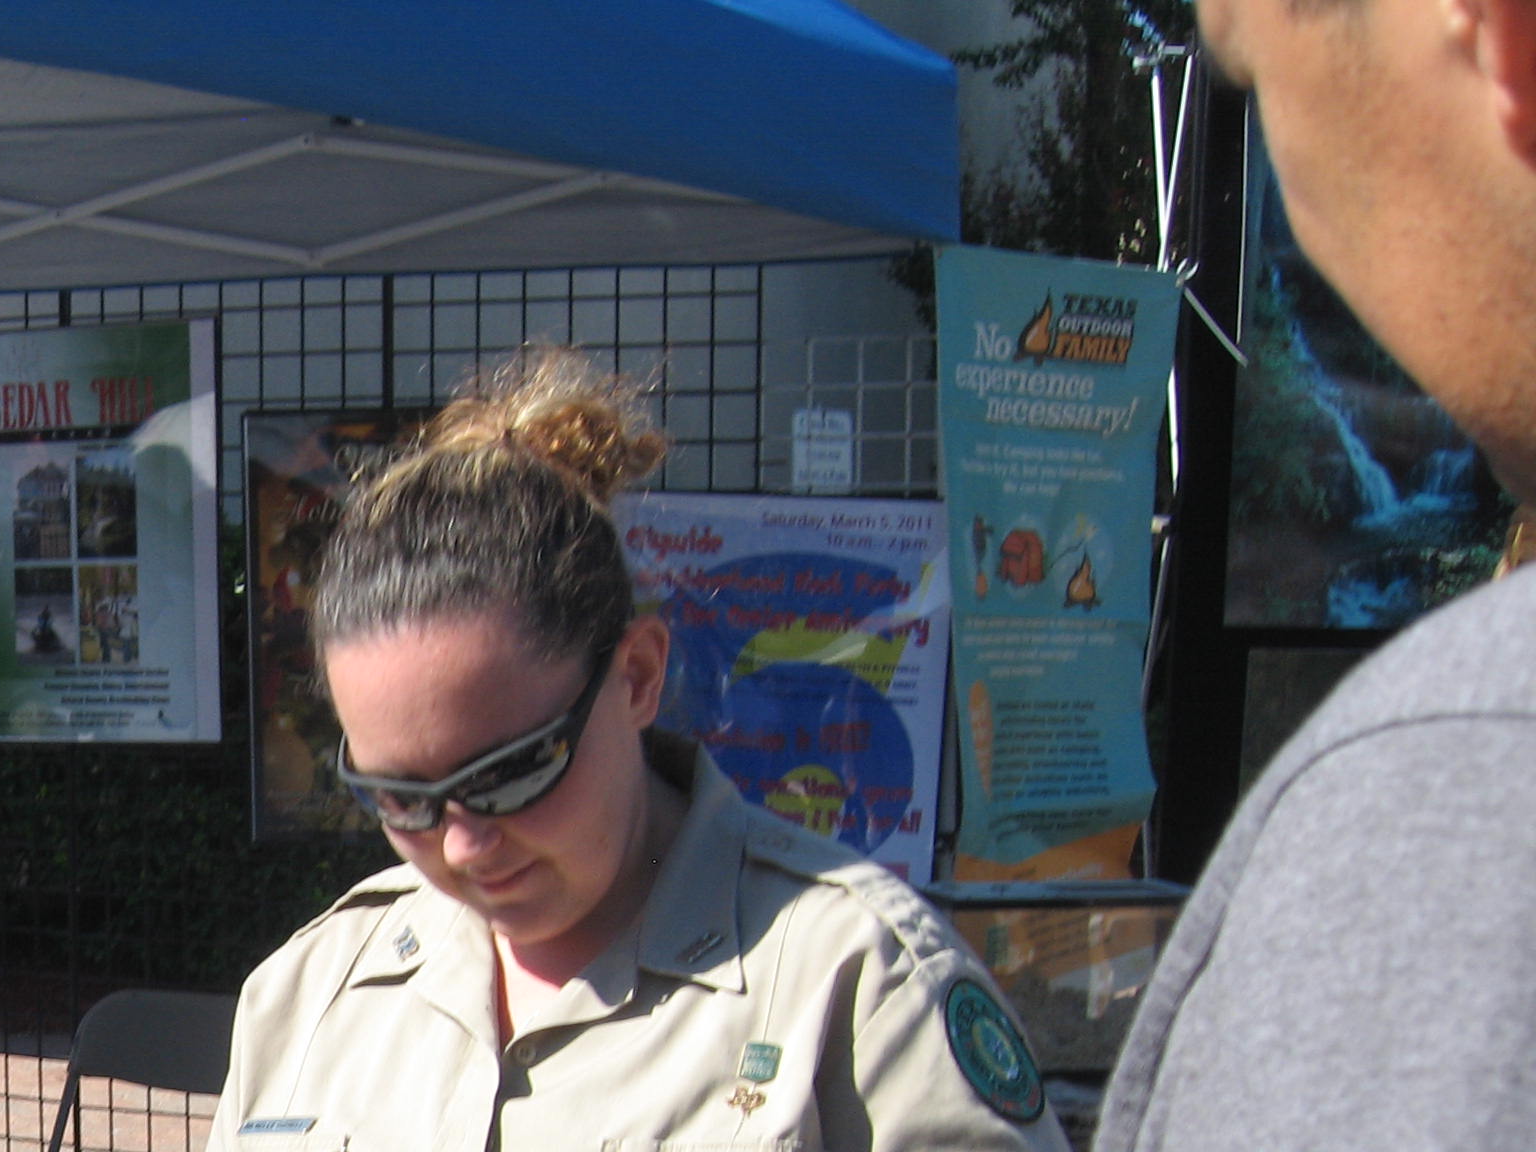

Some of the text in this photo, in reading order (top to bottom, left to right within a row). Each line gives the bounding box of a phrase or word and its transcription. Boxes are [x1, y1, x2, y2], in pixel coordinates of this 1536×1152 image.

[1063, 293, 1138, 316] TEXAS
[973, 321, 1012, 361] No
[1058, 314, 1133, 338] OUTDOOR
[1052, 333, 1131, 364] FAMILY
[955, 362, 1095, 399] experience
[985, 395, 1140, 439] necessary!
[830, 511, 875, 530] March
